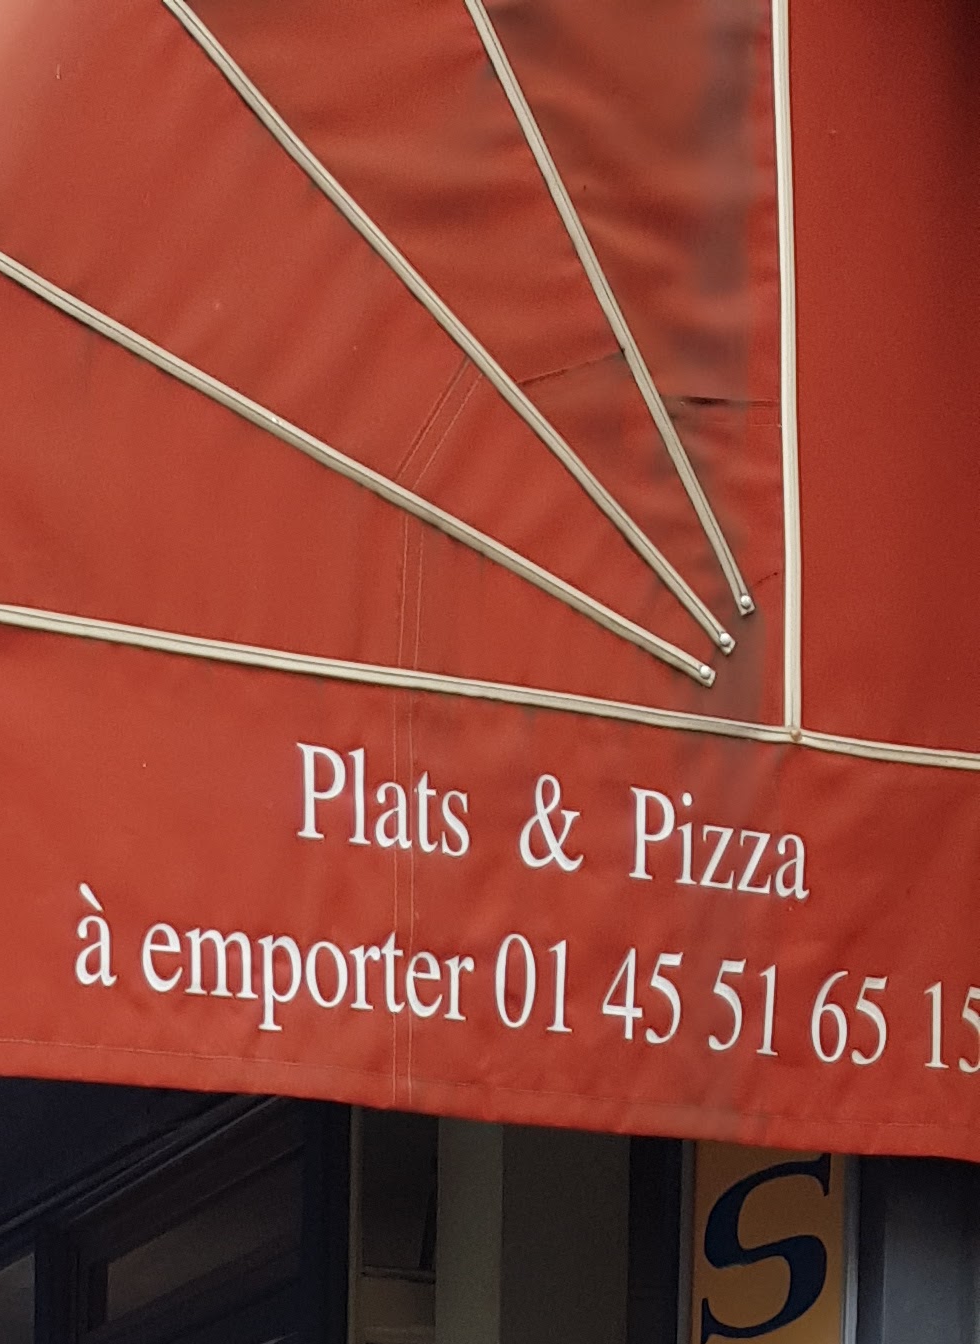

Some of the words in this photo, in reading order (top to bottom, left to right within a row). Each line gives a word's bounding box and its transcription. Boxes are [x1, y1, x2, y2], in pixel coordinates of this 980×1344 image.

[296, 742, 470, 857] Plats
[519, 774, 583, 872] &
[629, 786, 810, 900] Pizza
[75, 882, 118, 988] à
[141, 920, 475, 1032] emporter
[494, 933, 572, 1034] 01
[602, 947, 684, 1045] 45
[708, 958, 779, 1057] 51
[810, 970, 888, 1066] 65
[924, 981, 980, 1074] 15
